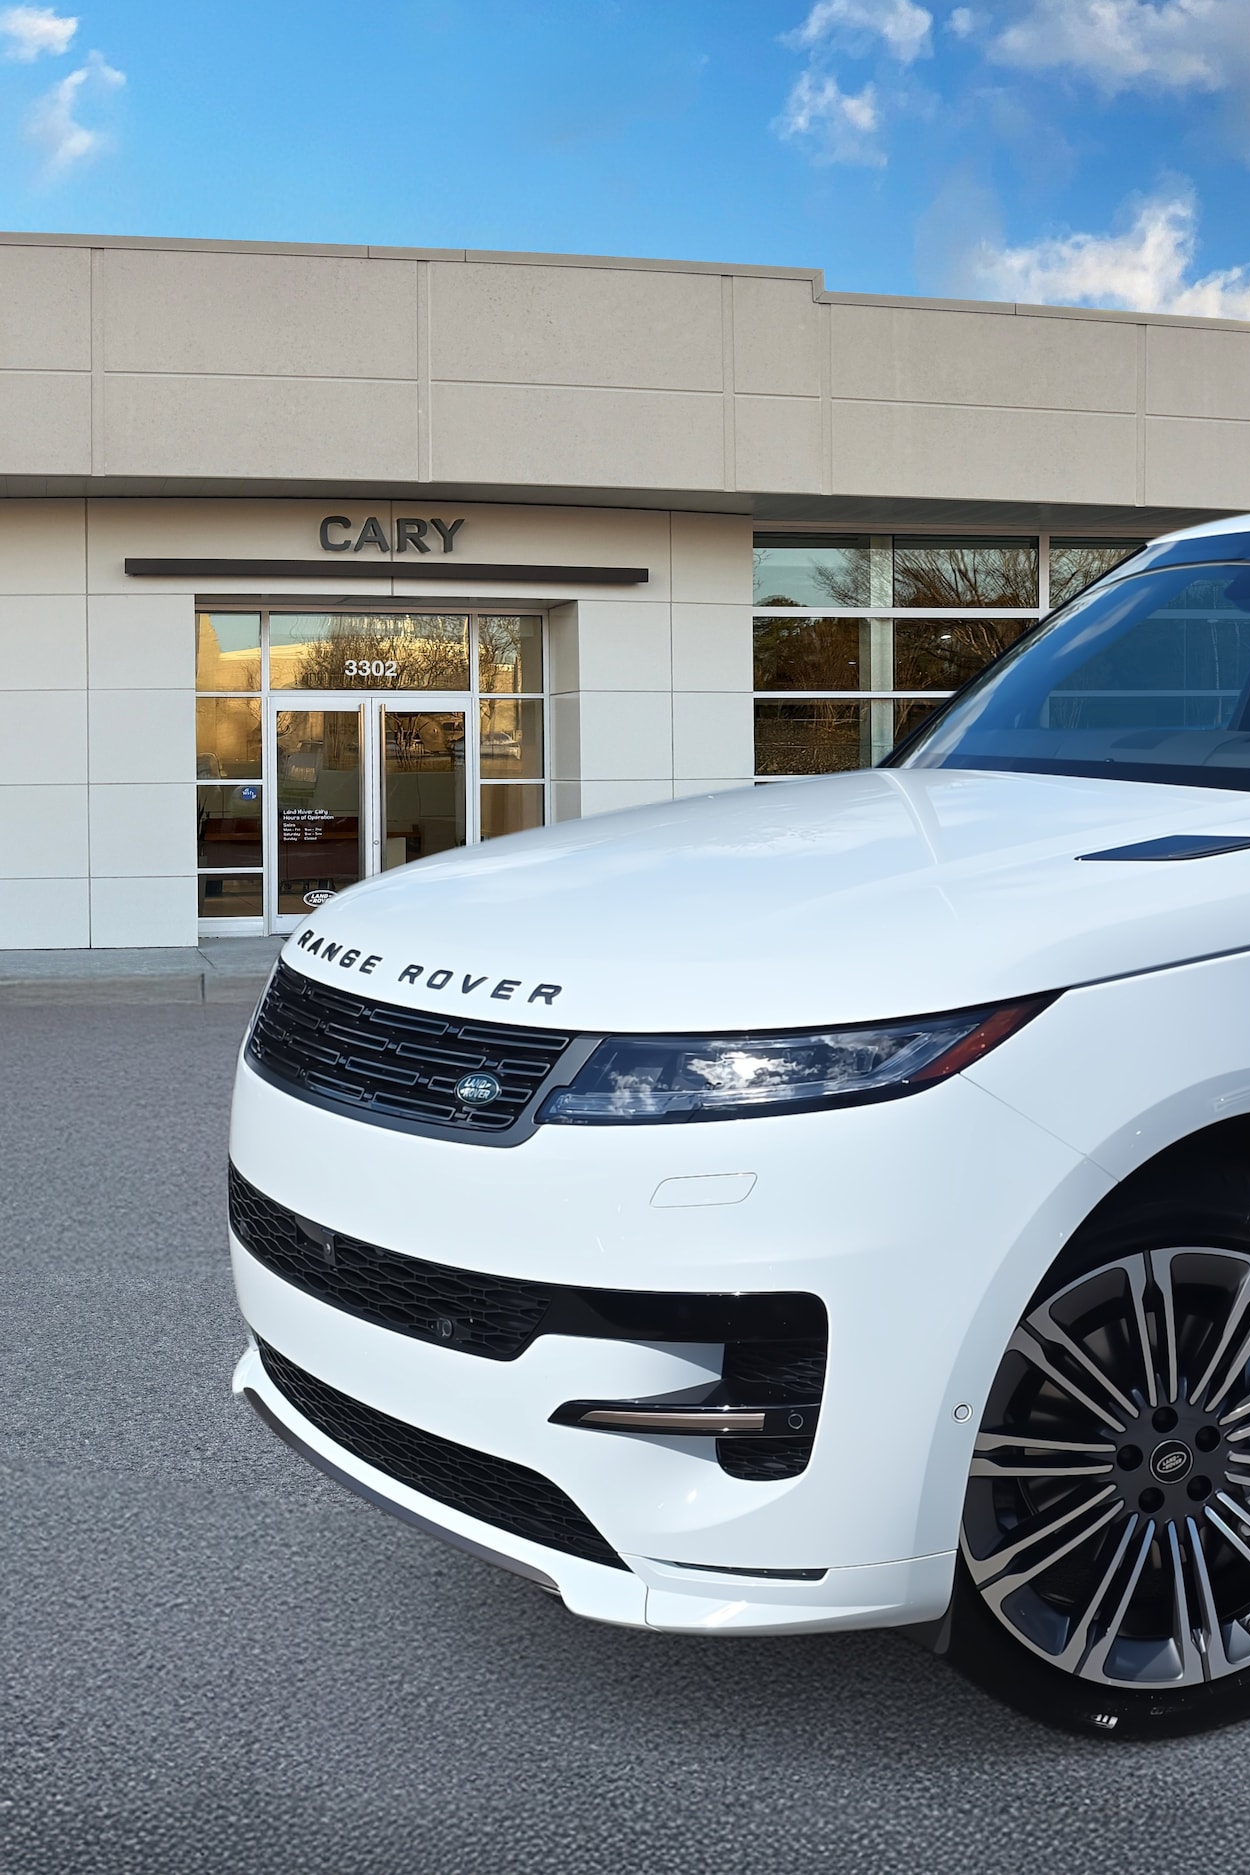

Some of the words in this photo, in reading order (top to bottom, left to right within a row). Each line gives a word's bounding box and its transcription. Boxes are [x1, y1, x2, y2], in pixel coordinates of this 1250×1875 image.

[319, 515, 466, 553] CARY
[344, 660, 398, 676] 3302
[297, 929, 383, 975] RANGE
[398, 964, 562, 1005] ROVER
[464, 1078, 487, 1089] LAND
[463, 1088, 490, 1099] ROVER
